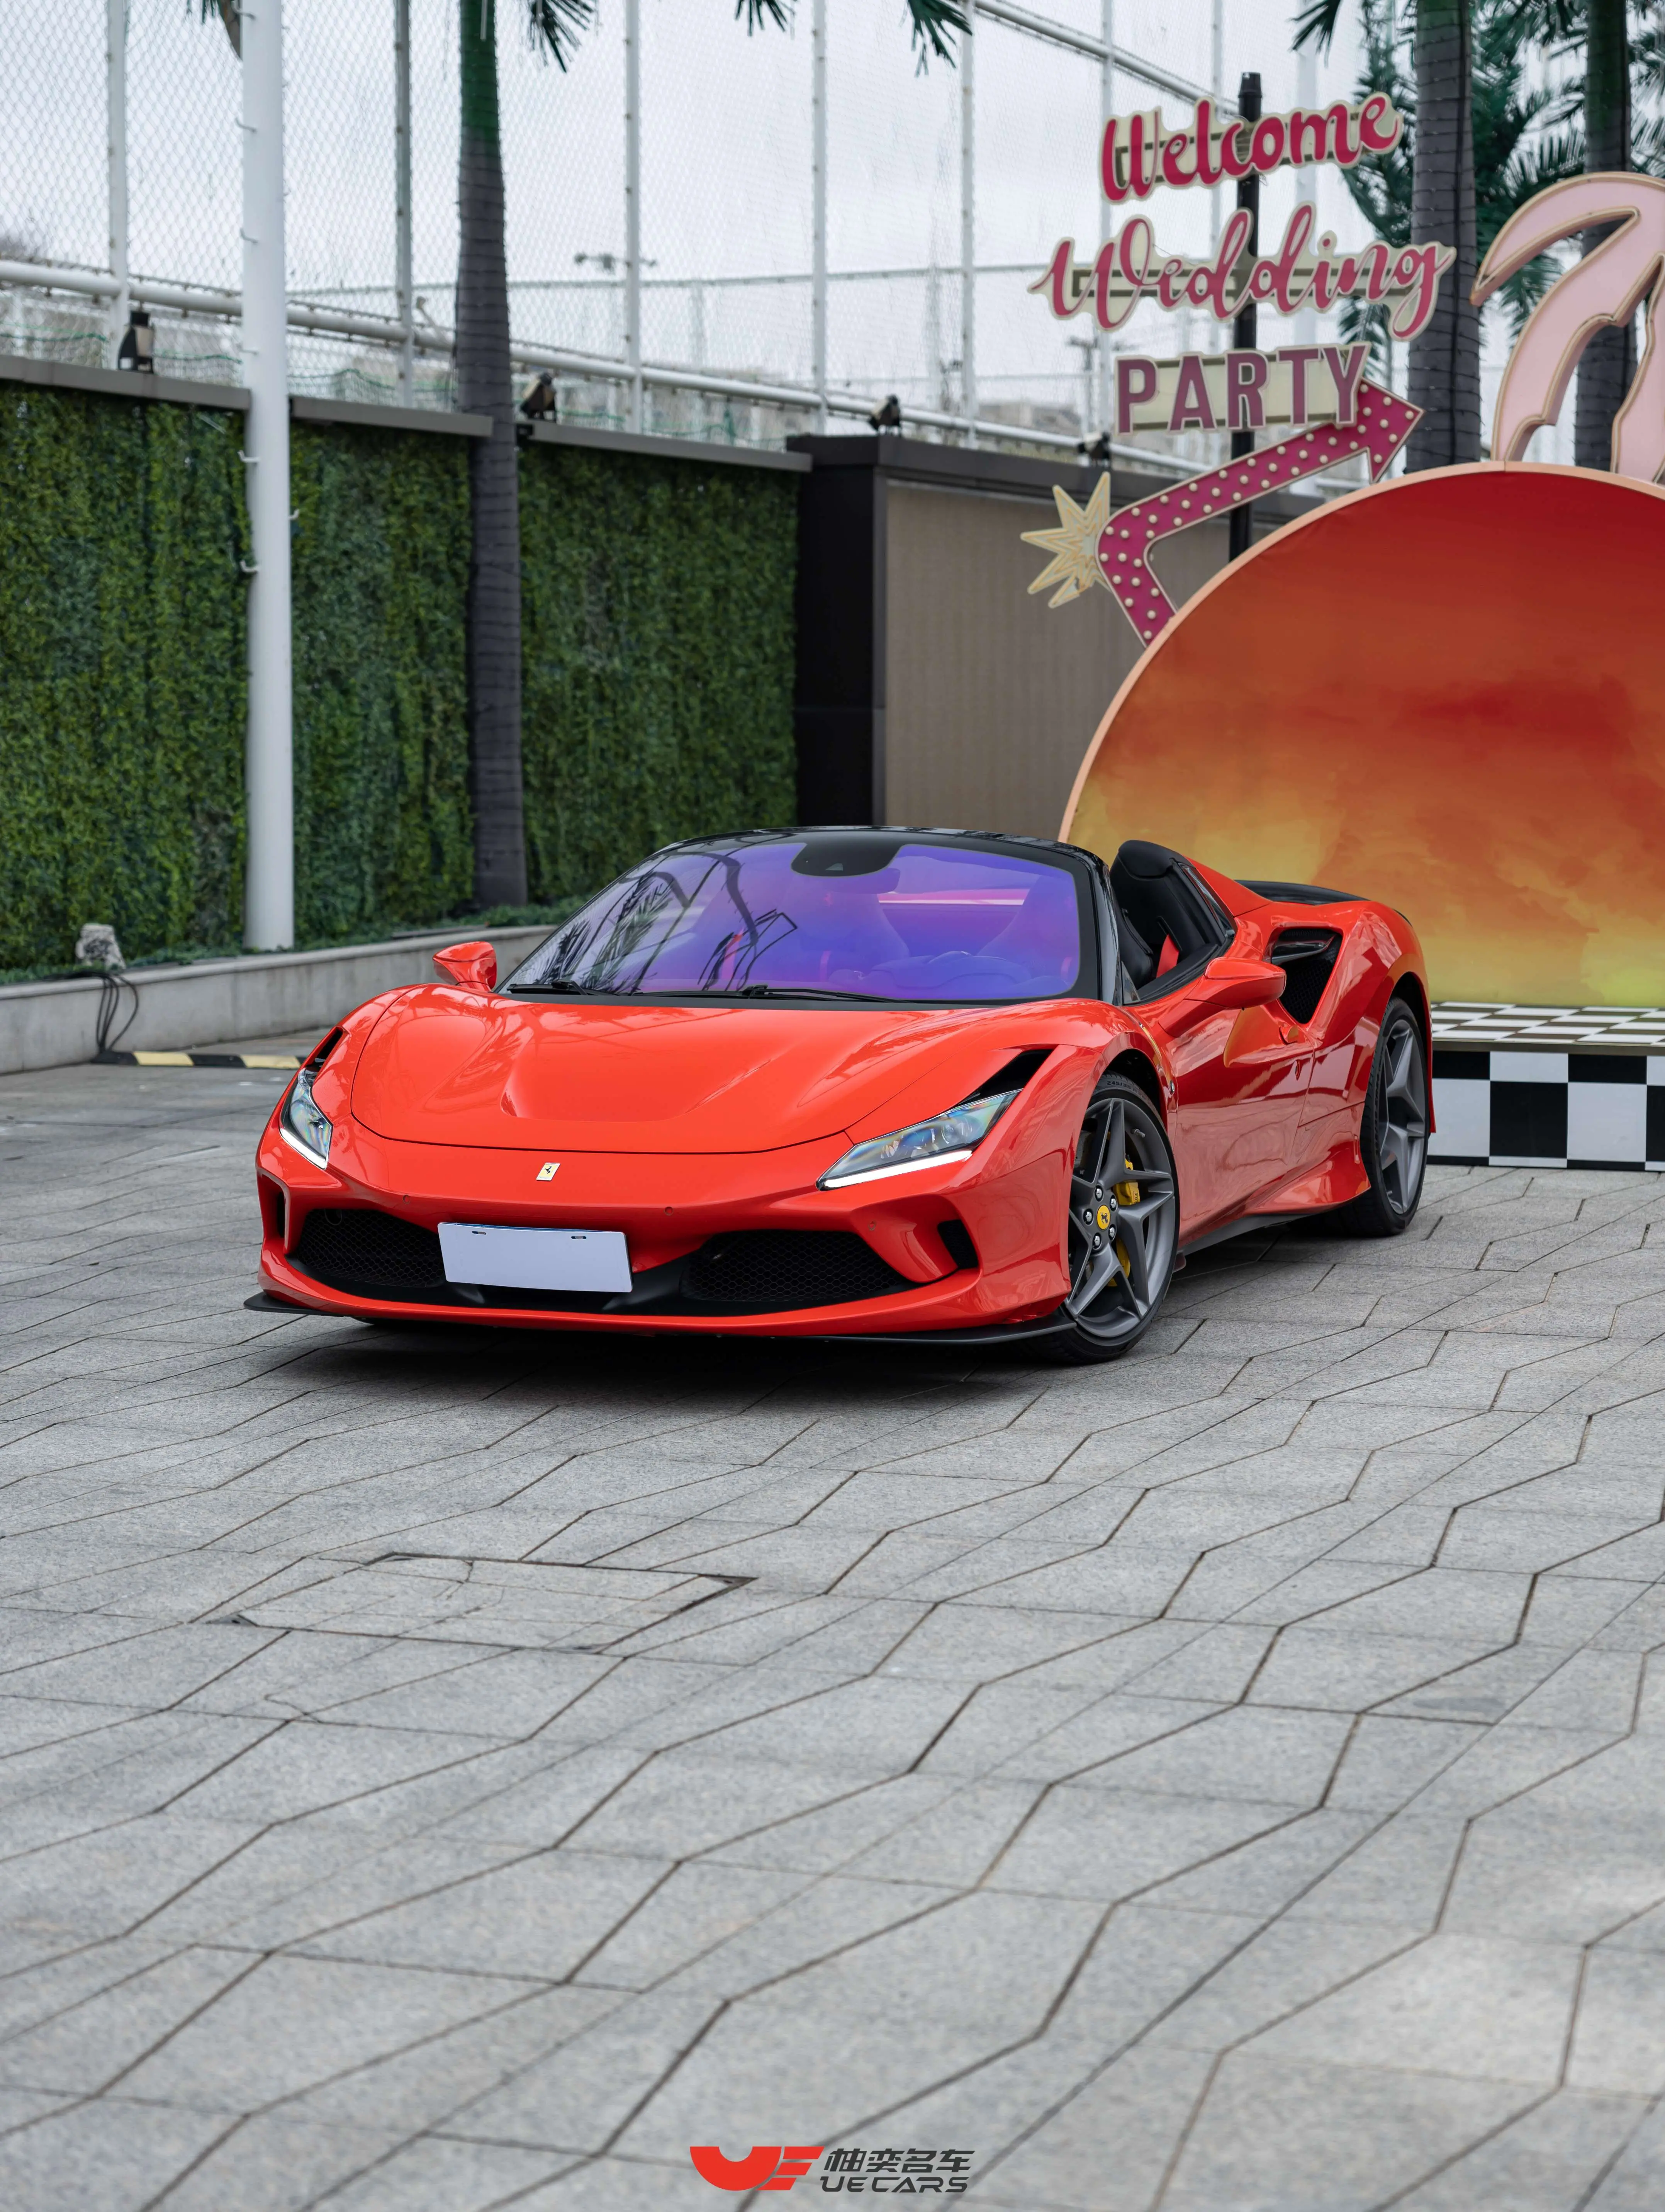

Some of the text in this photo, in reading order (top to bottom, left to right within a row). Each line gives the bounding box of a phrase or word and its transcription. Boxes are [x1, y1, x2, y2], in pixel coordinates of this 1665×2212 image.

[1102, 96, 1399, 201] Welcome
[1029, 205, 1454, 338] Wedding
[1117, 345, 1370, 435] PARTY
